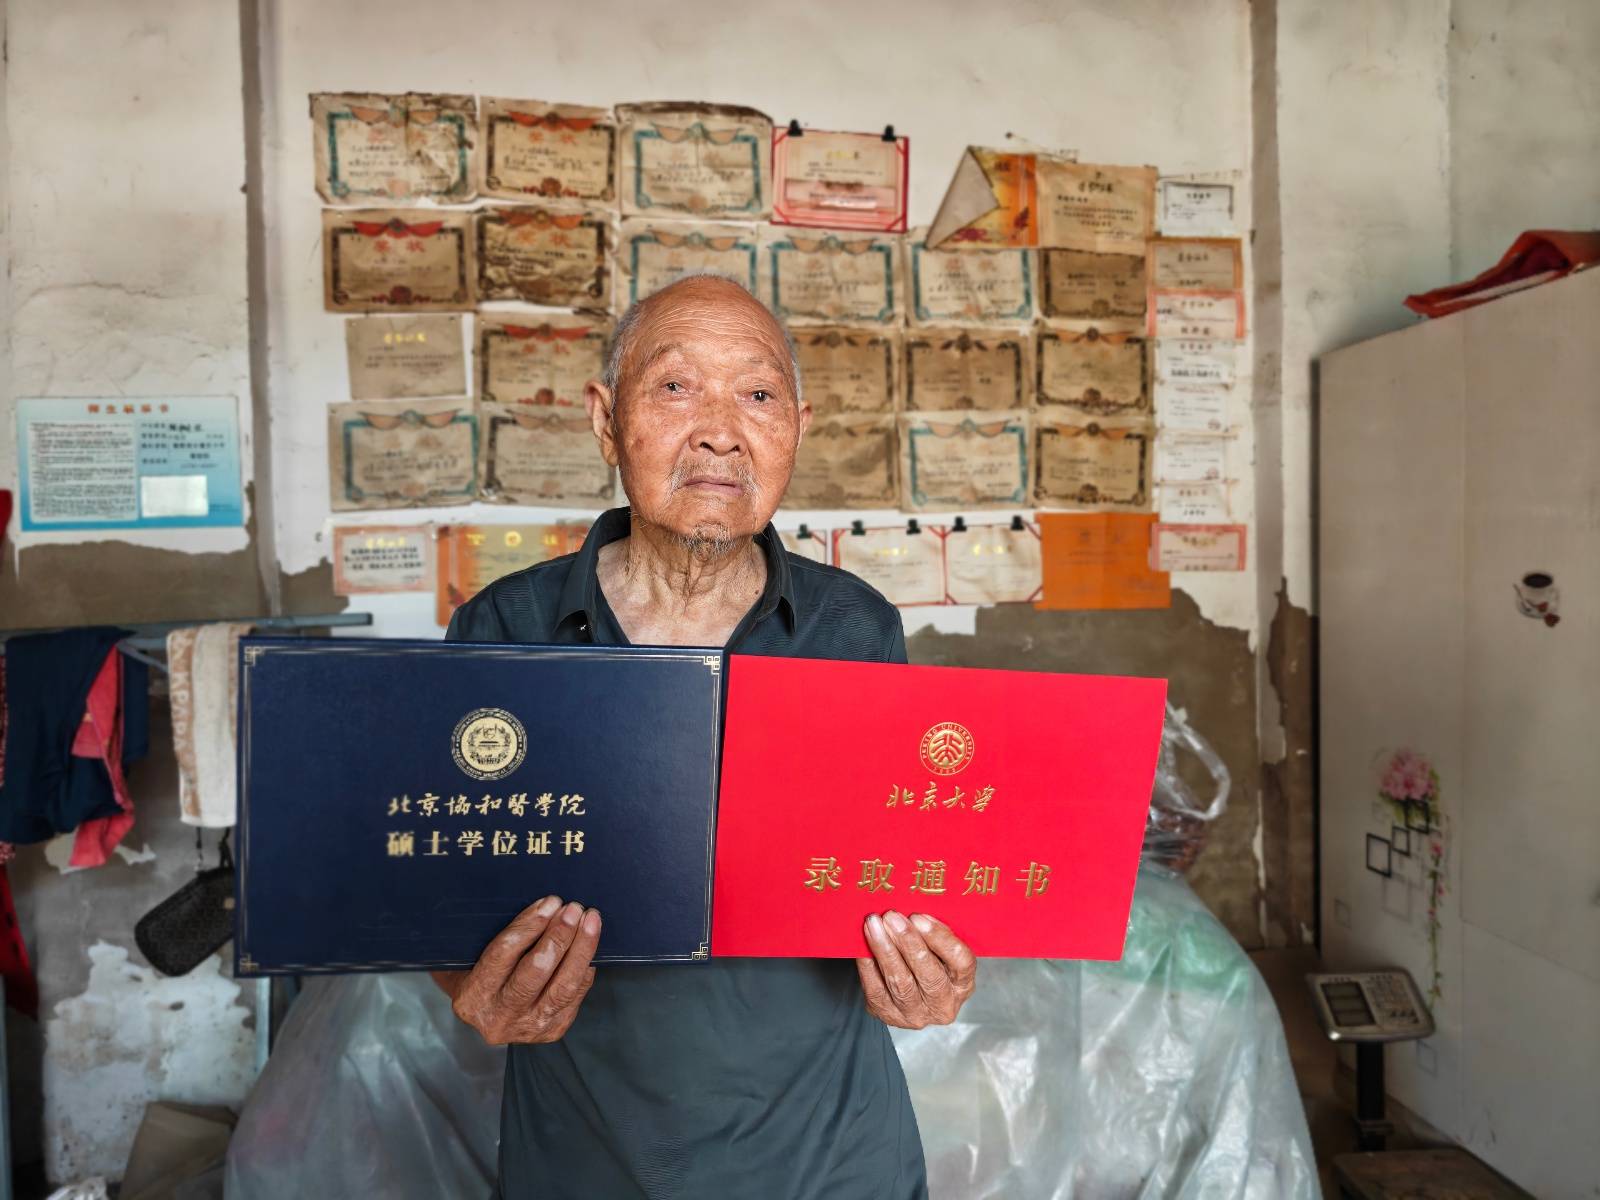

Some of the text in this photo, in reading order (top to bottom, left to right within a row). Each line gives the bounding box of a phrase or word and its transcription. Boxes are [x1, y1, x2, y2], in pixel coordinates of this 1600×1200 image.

[921, 727, 938, 760] PEKING
[387, 830, 587, 856] 硕士学位证书
[803, 856, 1053, 900] 录取通知书
